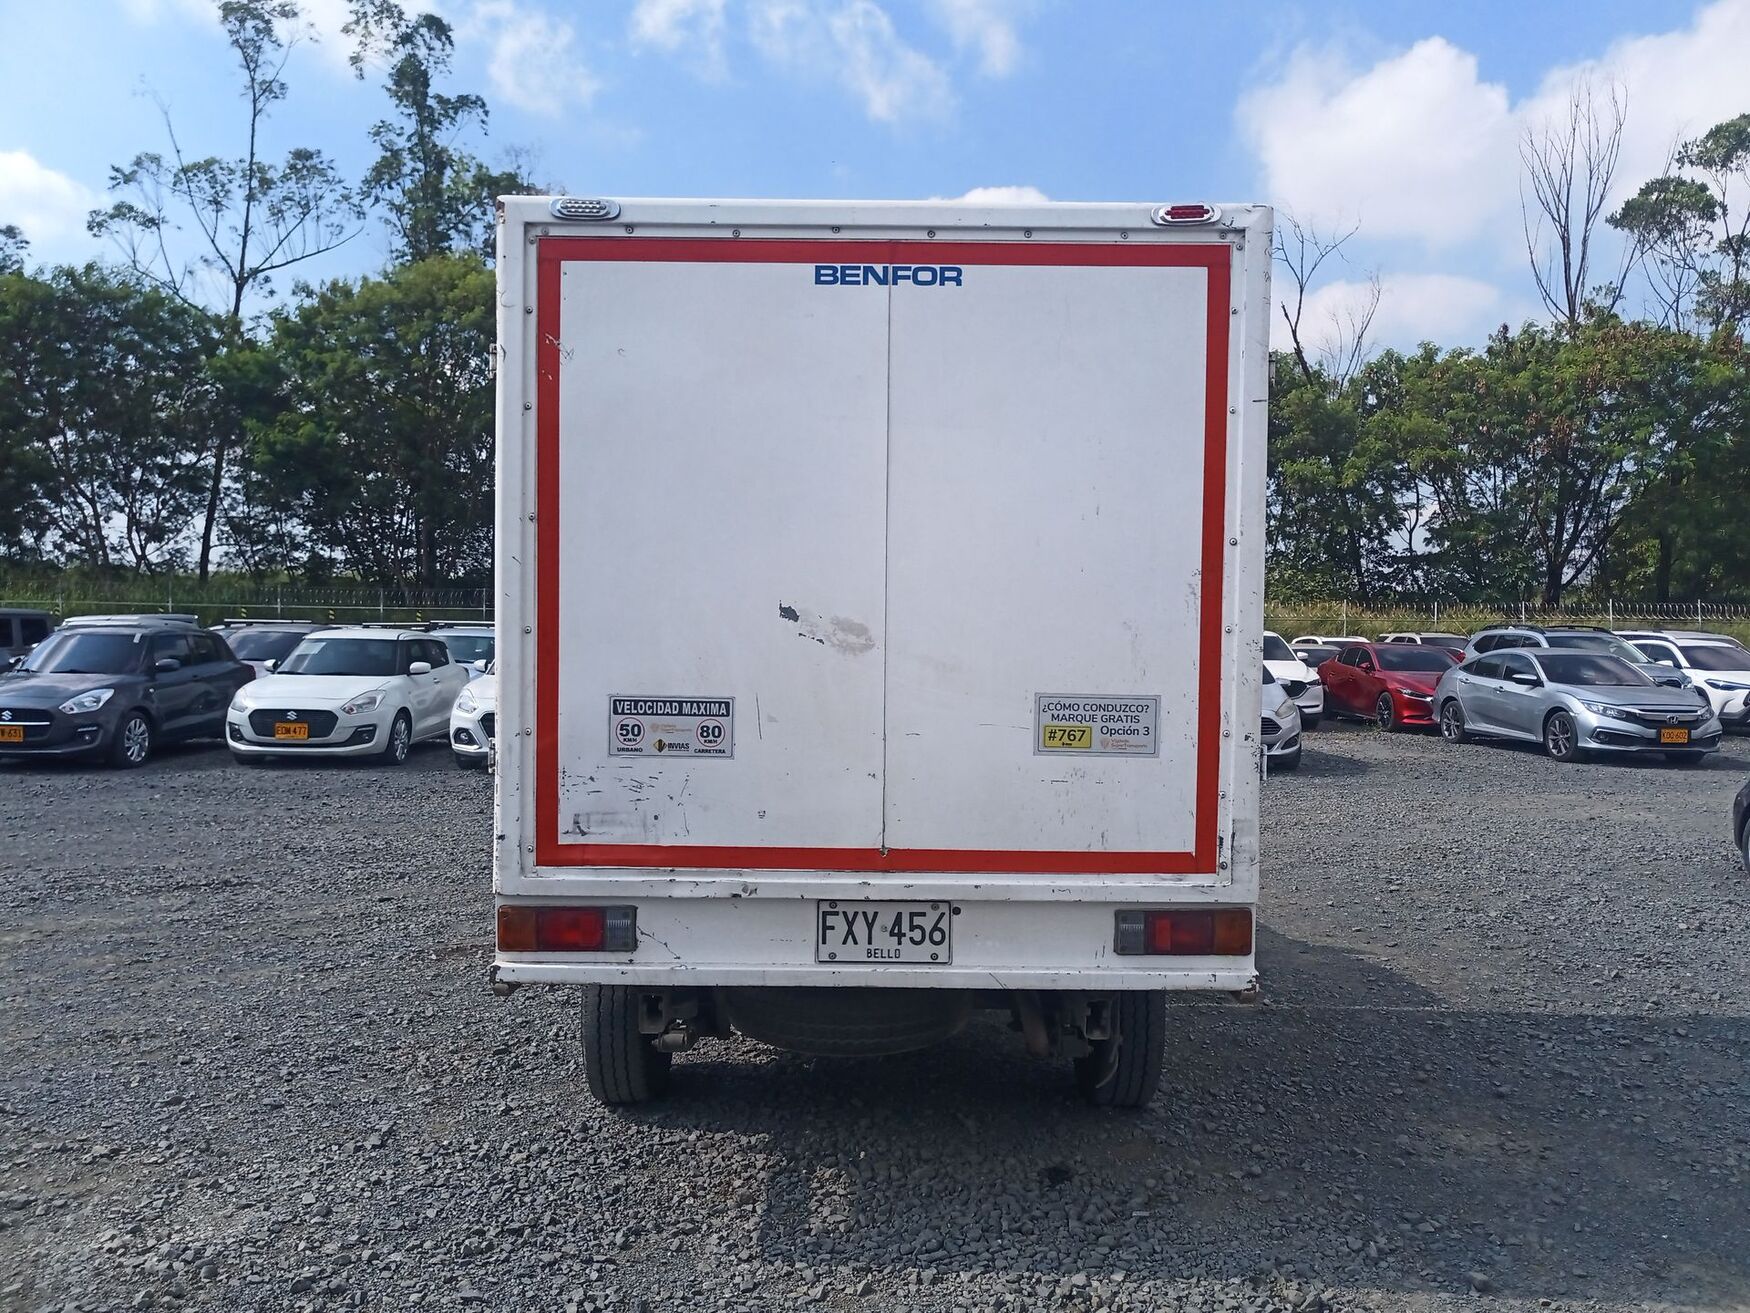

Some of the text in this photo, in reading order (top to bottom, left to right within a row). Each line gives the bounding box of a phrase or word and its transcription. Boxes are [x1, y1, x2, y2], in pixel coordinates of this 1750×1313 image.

[814, 265, 963, 287] BENFOR
[616, 701, 727, 716] VELOCIDAD MAXIMA
[1042, 700, 1150, 713] ¿CÓMO CONDUZCO?
[1051, 713, 1141, 724] MARQUE GRATIS
[619, 723, 642, 738] 50
[699, 725, 722, 738] 80
[1048, 729, 1086, 742] #767
[1100, 725, 1150, 737] Opción 3
[821, 911, 946, 946] FXY 456
[866, 948, 901, 959] BELLO
